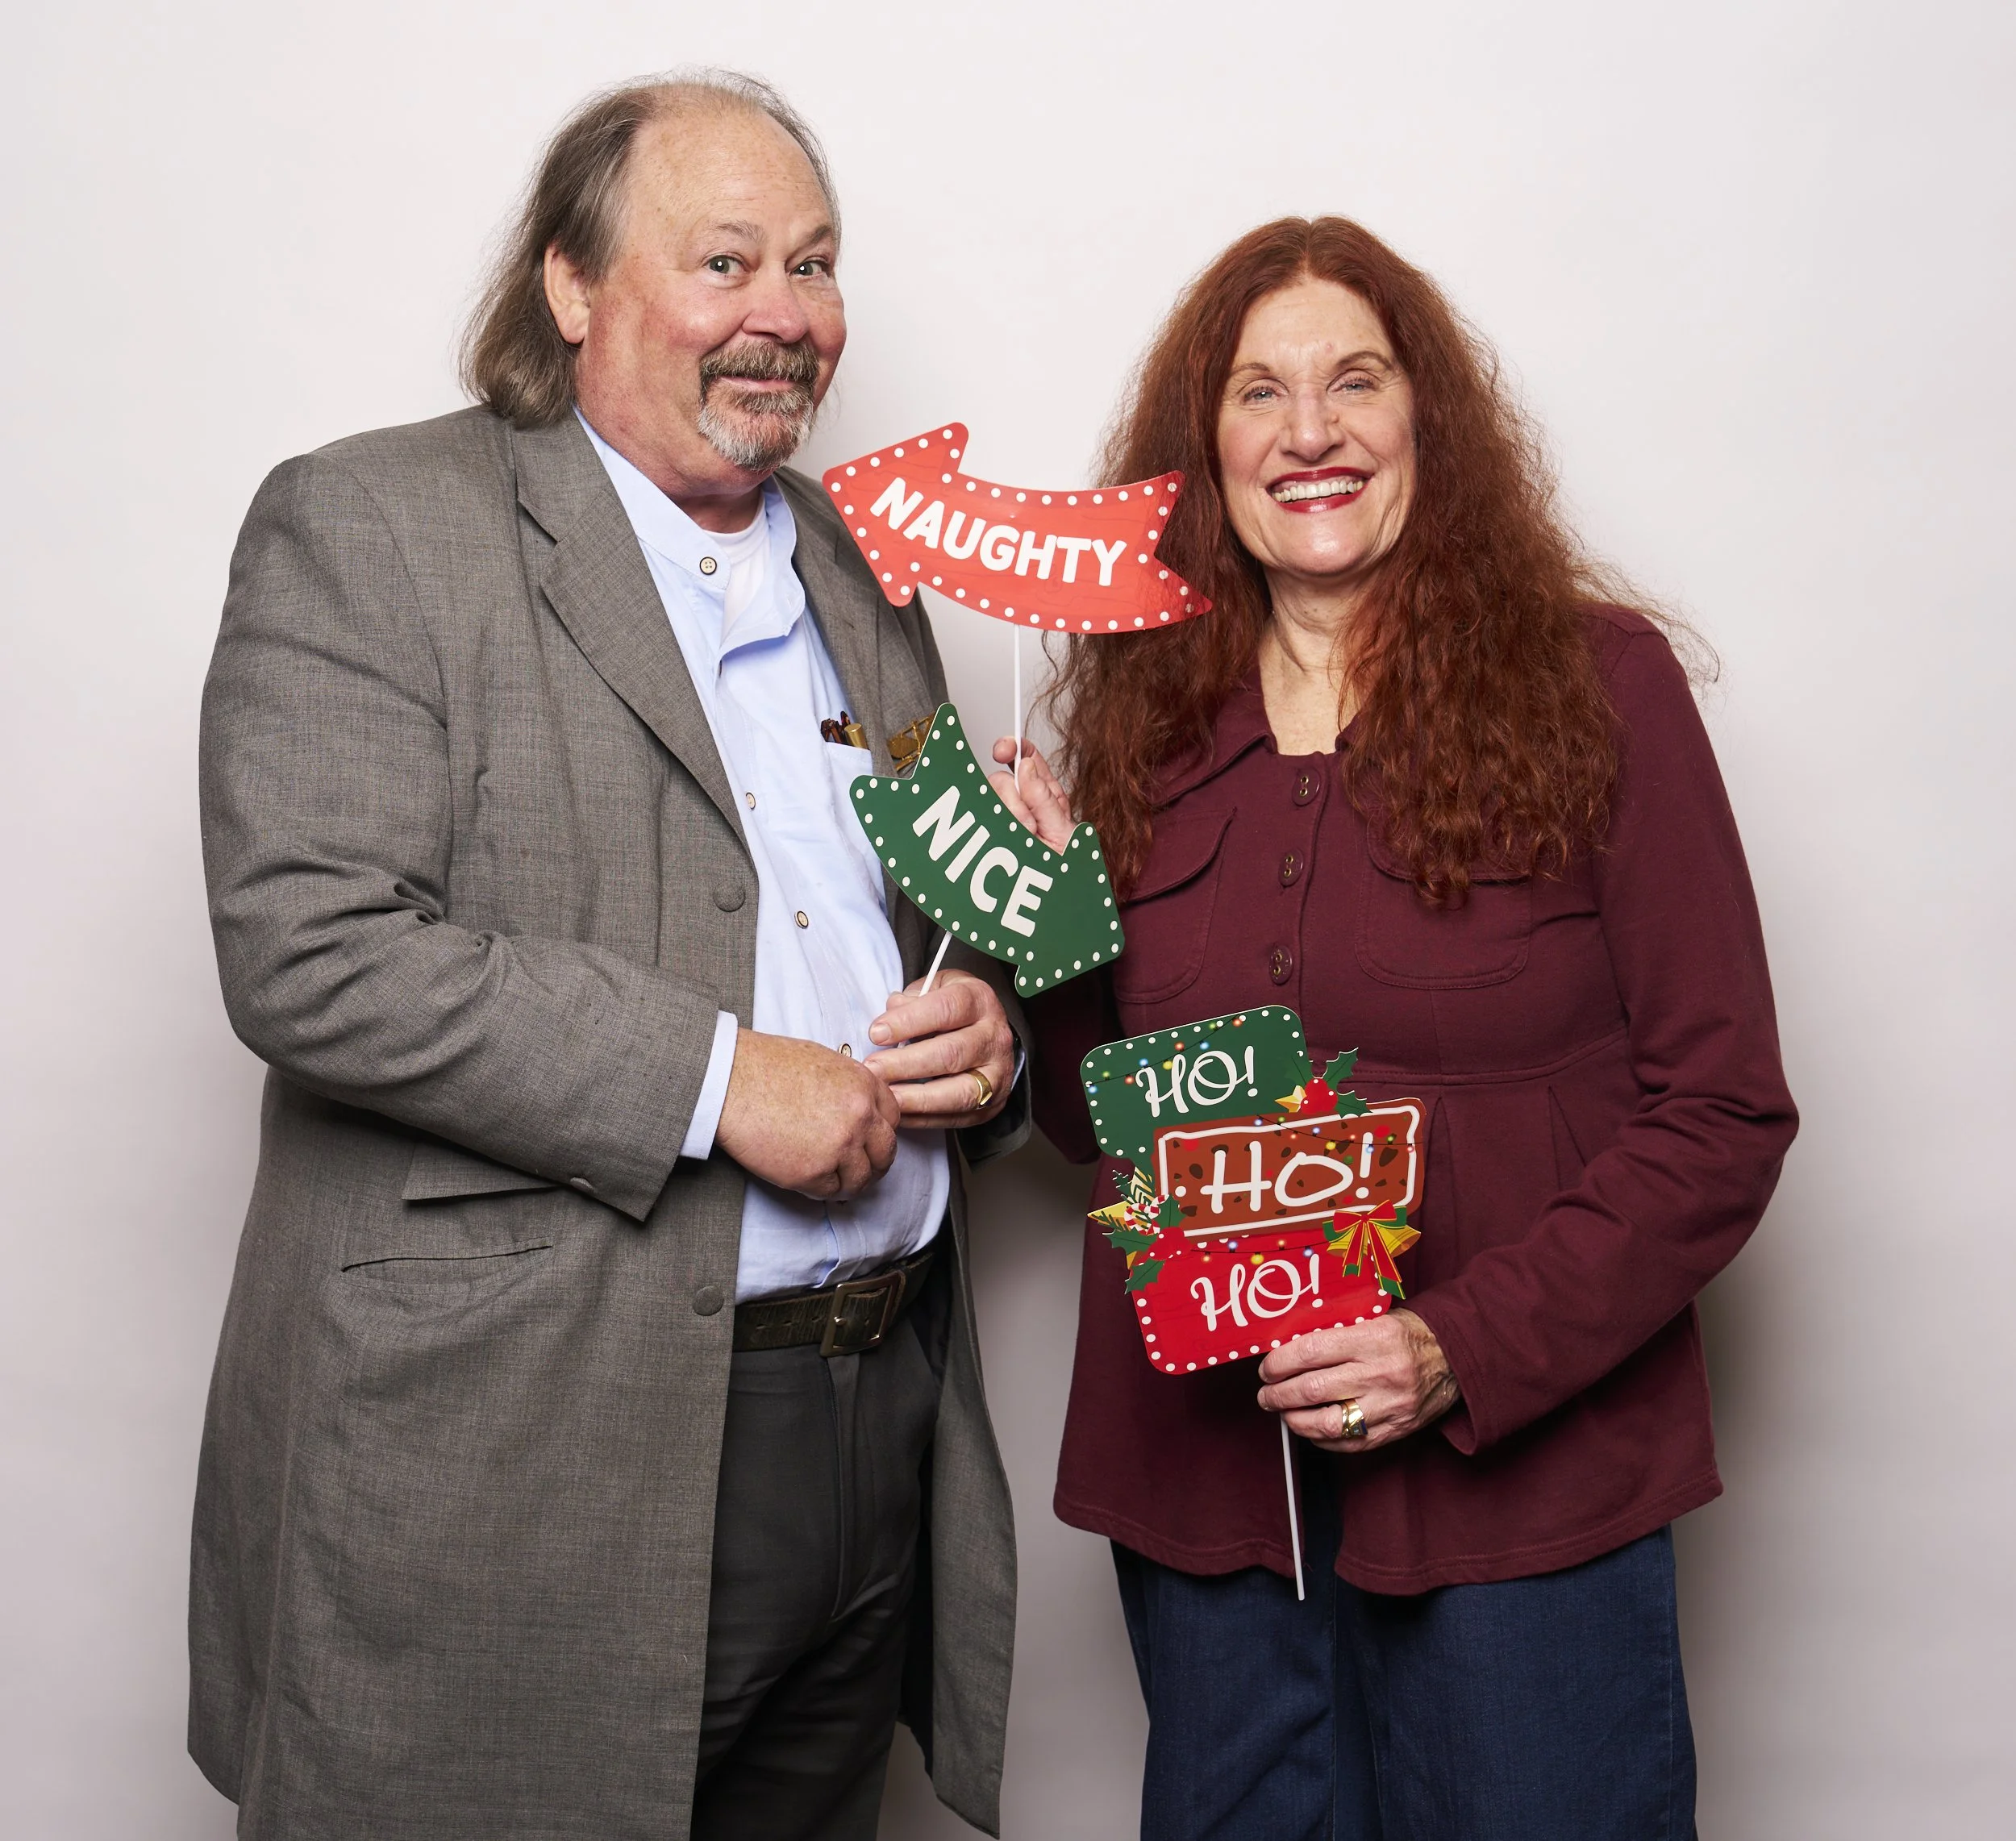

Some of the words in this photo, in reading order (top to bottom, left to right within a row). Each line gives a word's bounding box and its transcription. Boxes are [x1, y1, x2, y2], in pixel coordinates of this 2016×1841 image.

[870, 477, 1127, 586] NAUGHTY
[912, 785, 1053, 937] NICE
[1135, 1046, 1258, 1117] HO!
[1201, 1132, 1372, 1214] HO!
[1191, 1254, 1323, 1331] HO!
